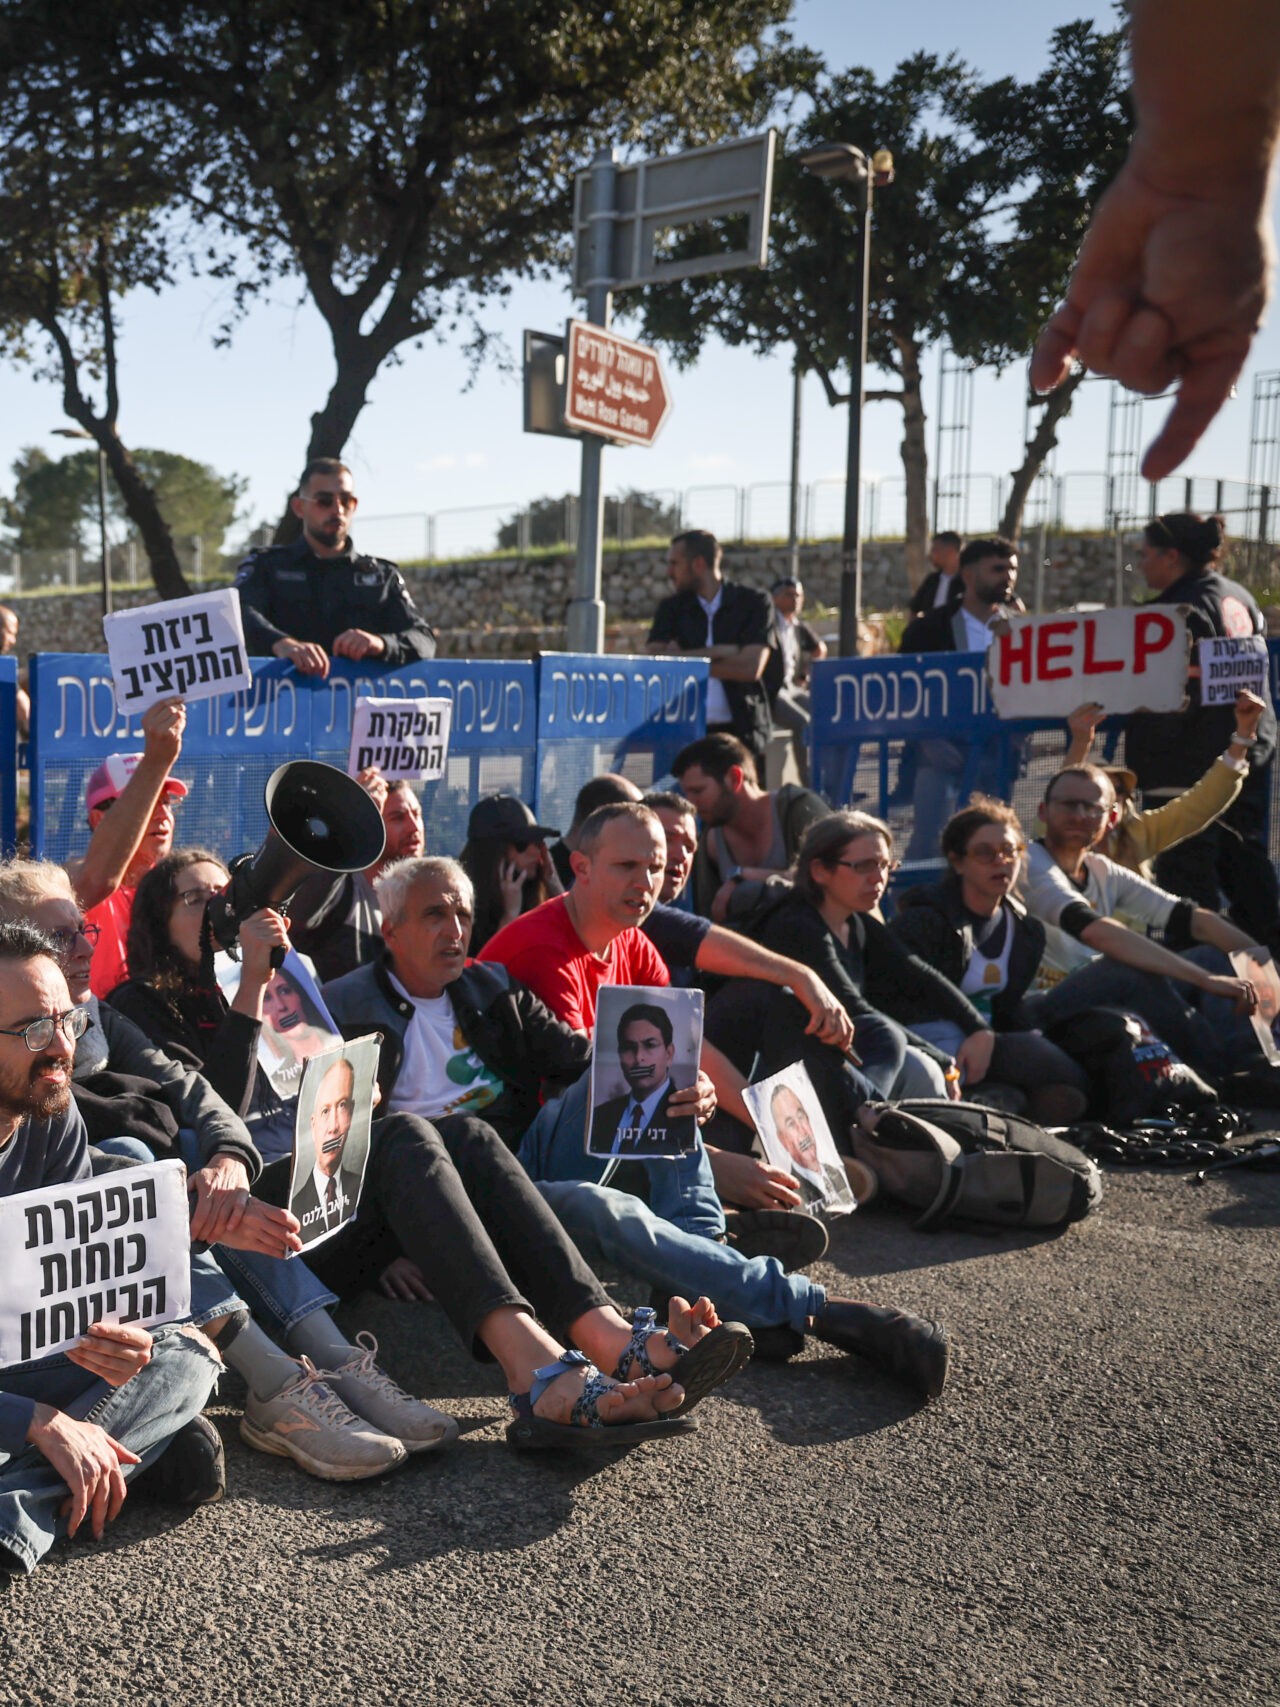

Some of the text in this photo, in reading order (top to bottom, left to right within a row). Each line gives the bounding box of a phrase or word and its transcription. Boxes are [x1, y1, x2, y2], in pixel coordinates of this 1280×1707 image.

[598, 400, 619, 426] Rose
[620, 407, 649, 435] Garden
[141, 612, 213, 656] ביזת
[1000, 612, 1175, 686] HELP
[121, 645, 243, 700] התקציב
[548, 671, 699, 724] משמר הכנסת
[831, 668, 949, 724] הכנסת
[367, 711, 442, 744] הפקרת
[357, 744, 444, 772] המפונים
[616, 1127, 667, 1144] דני דנון
[24, 1178, 157, 1250] הפקרת
[39, 1233, 147, 1298] כוחות
[20, 1275, 167, 1362] הביטחון
